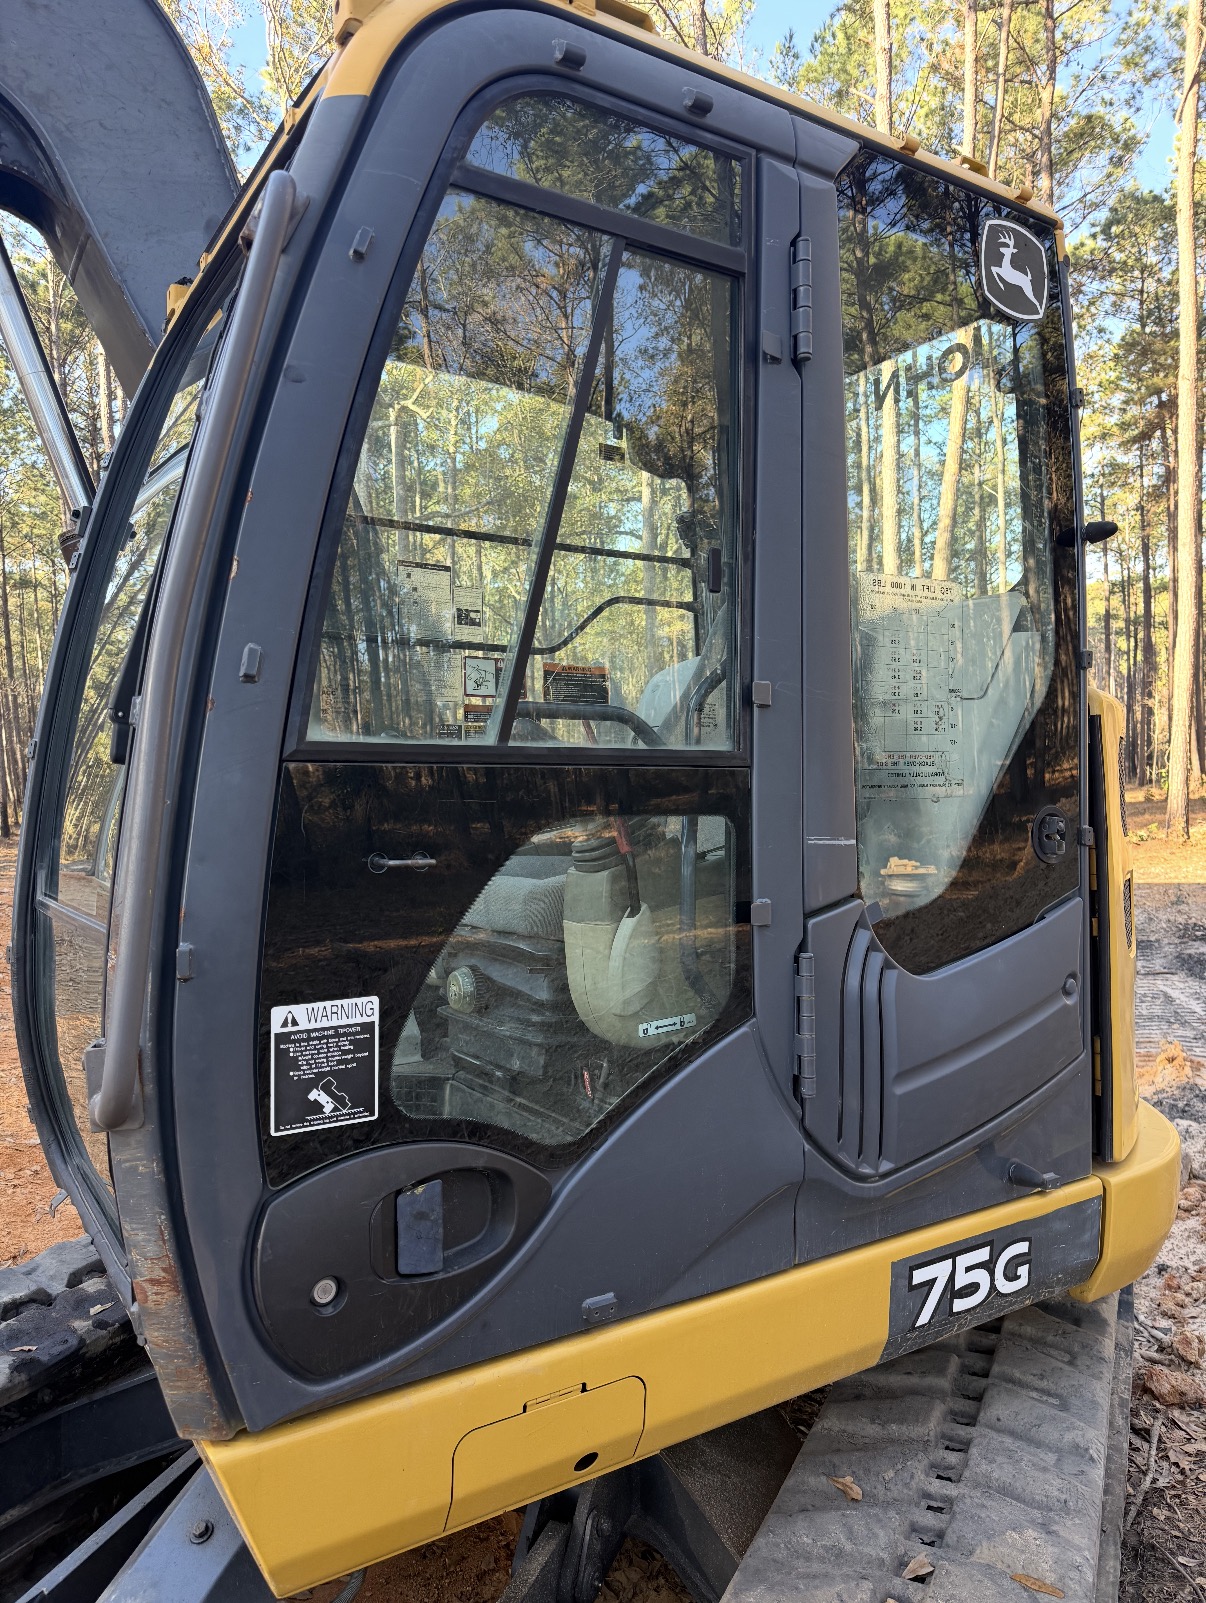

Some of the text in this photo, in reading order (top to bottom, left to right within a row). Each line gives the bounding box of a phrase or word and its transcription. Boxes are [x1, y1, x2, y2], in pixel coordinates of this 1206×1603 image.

[306, 1000, 375, 1024] WARNING
[310, 1029, 335, 1038] MACHINE
[910, 1240, 1031, 1329] 75G
